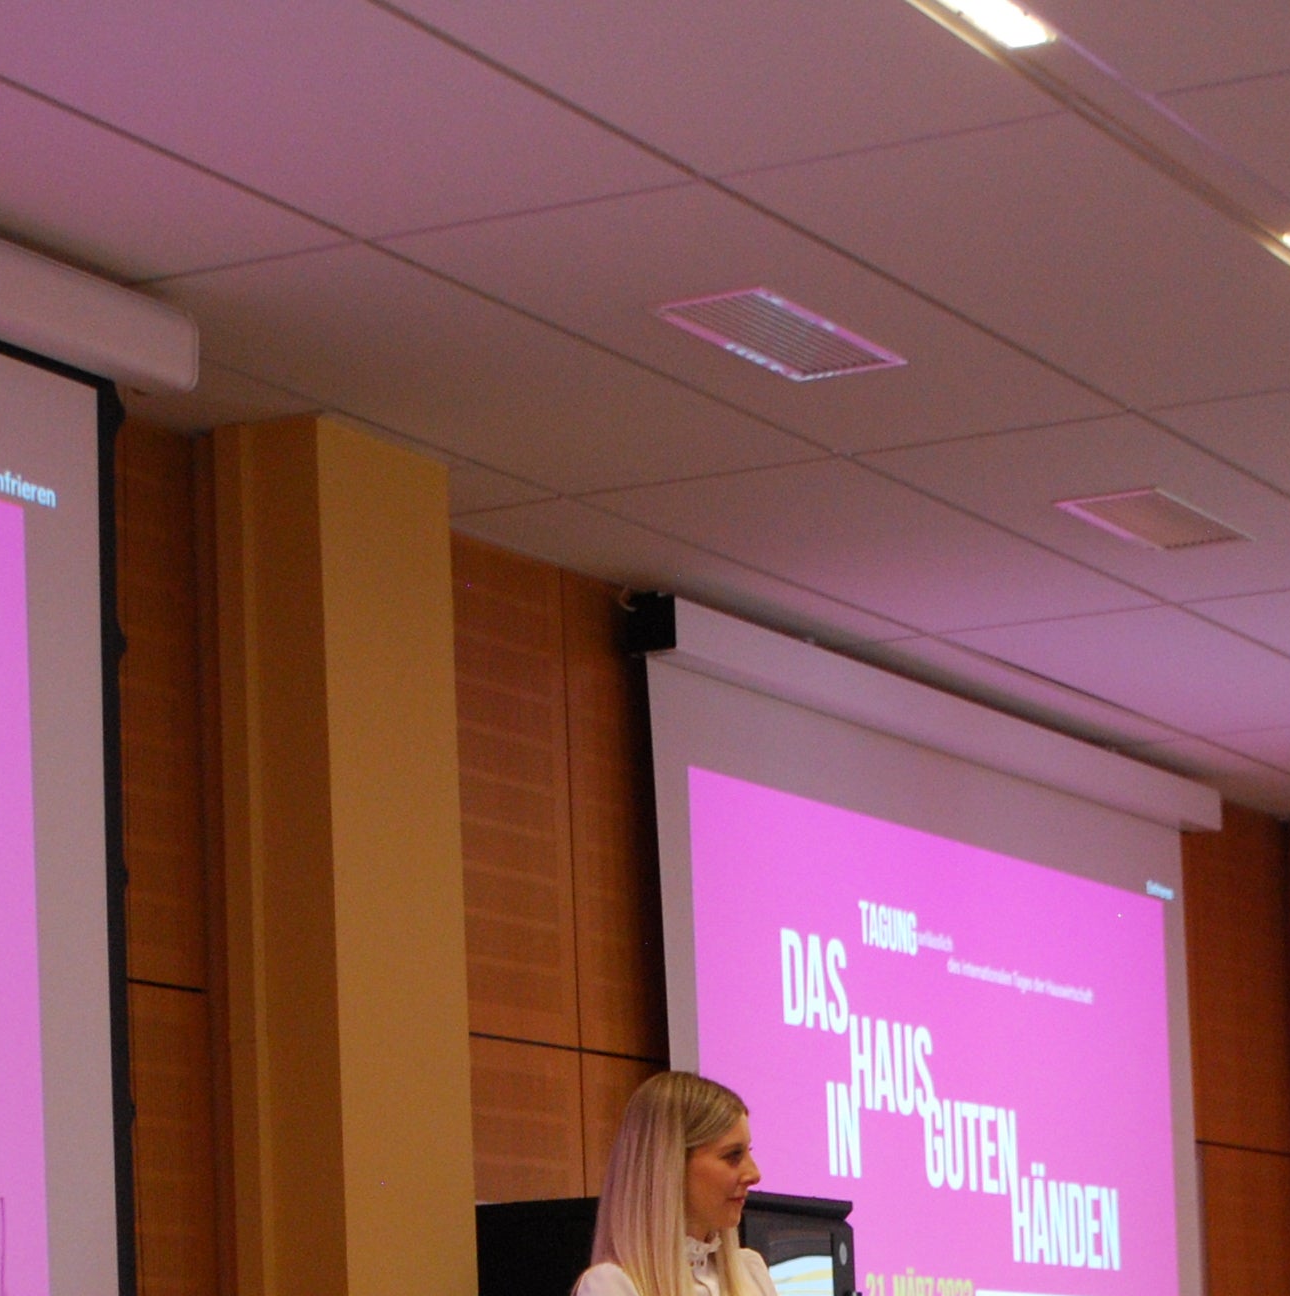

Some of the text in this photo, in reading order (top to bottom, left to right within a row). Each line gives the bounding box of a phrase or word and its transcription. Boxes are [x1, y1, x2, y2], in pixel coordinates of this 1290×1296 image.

[858, 899, 918, 957] TAGUNG
[780, 928, 848, 1035] DAS
[849, 1014, 936, 1118] HAUS
[826, 1080, 862, 1179] IN
[923, 1097, 1018, 1197] GUTEN
[1010, 1162, 1121, 1271] HÄNDEN
